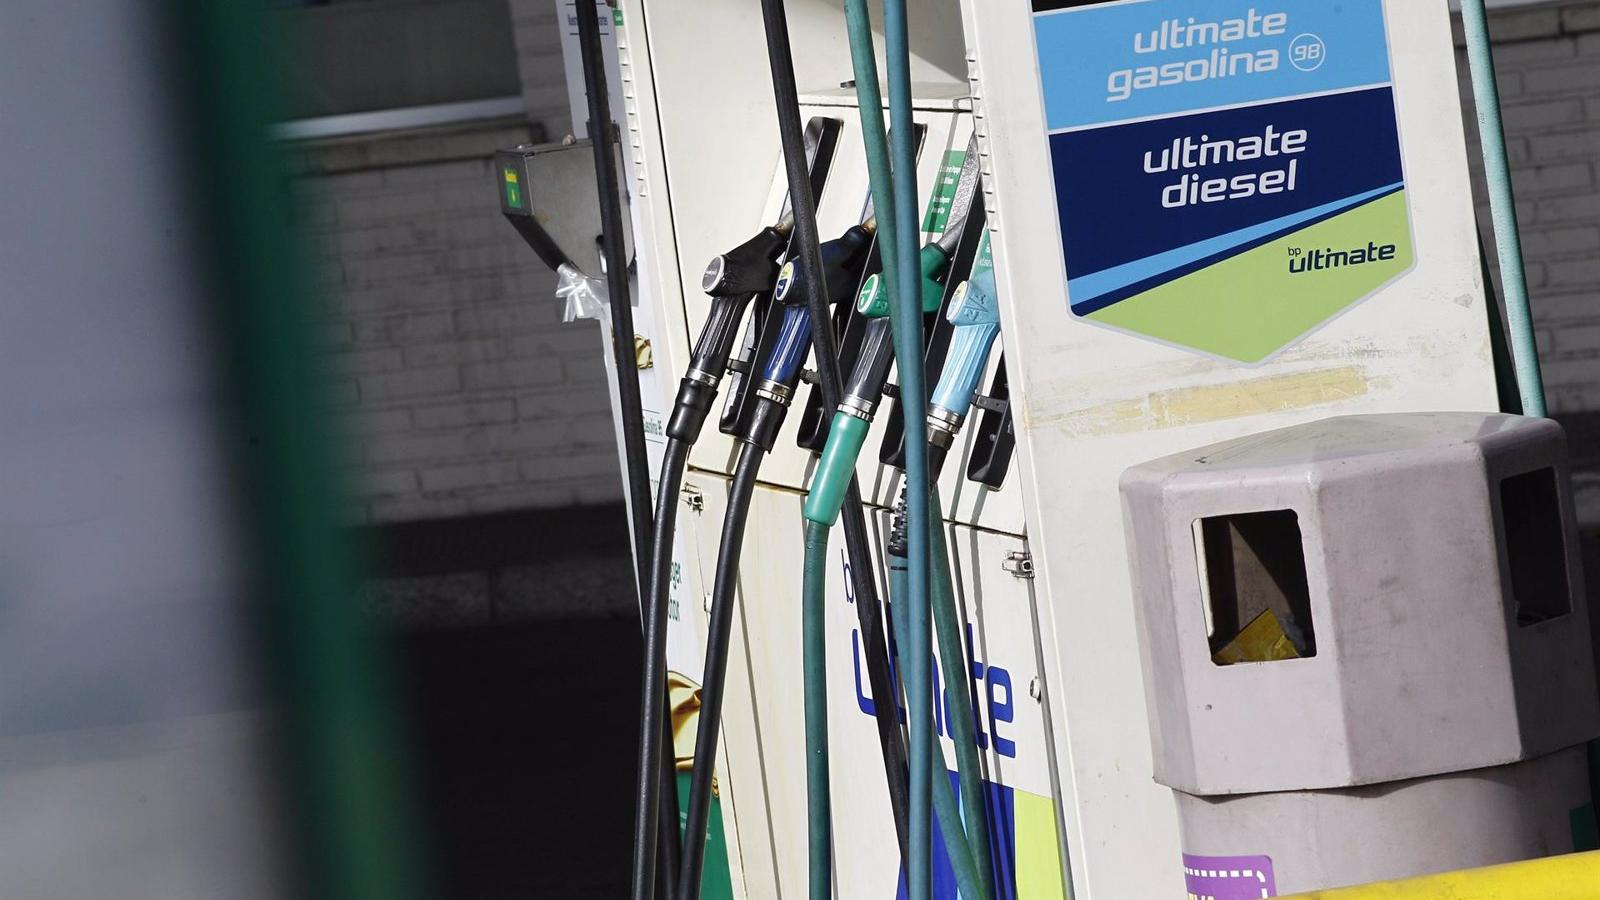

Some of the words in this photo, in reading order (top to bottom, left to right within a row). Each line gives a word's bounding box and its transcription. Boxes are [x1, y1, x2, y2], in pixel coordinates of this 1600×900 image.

[1134, 8, 1287, 54] ultimate
[1107, 48, 1280, 102] gasolina
[1295, 43, 1321, 61] 98
[1144, 125, 1308, 174] ultimate
[1161, 159, 1297, 208] diesel
[1287, 246, 1302, 259] bp
[1288, 241, 1396, 274] ultimate
